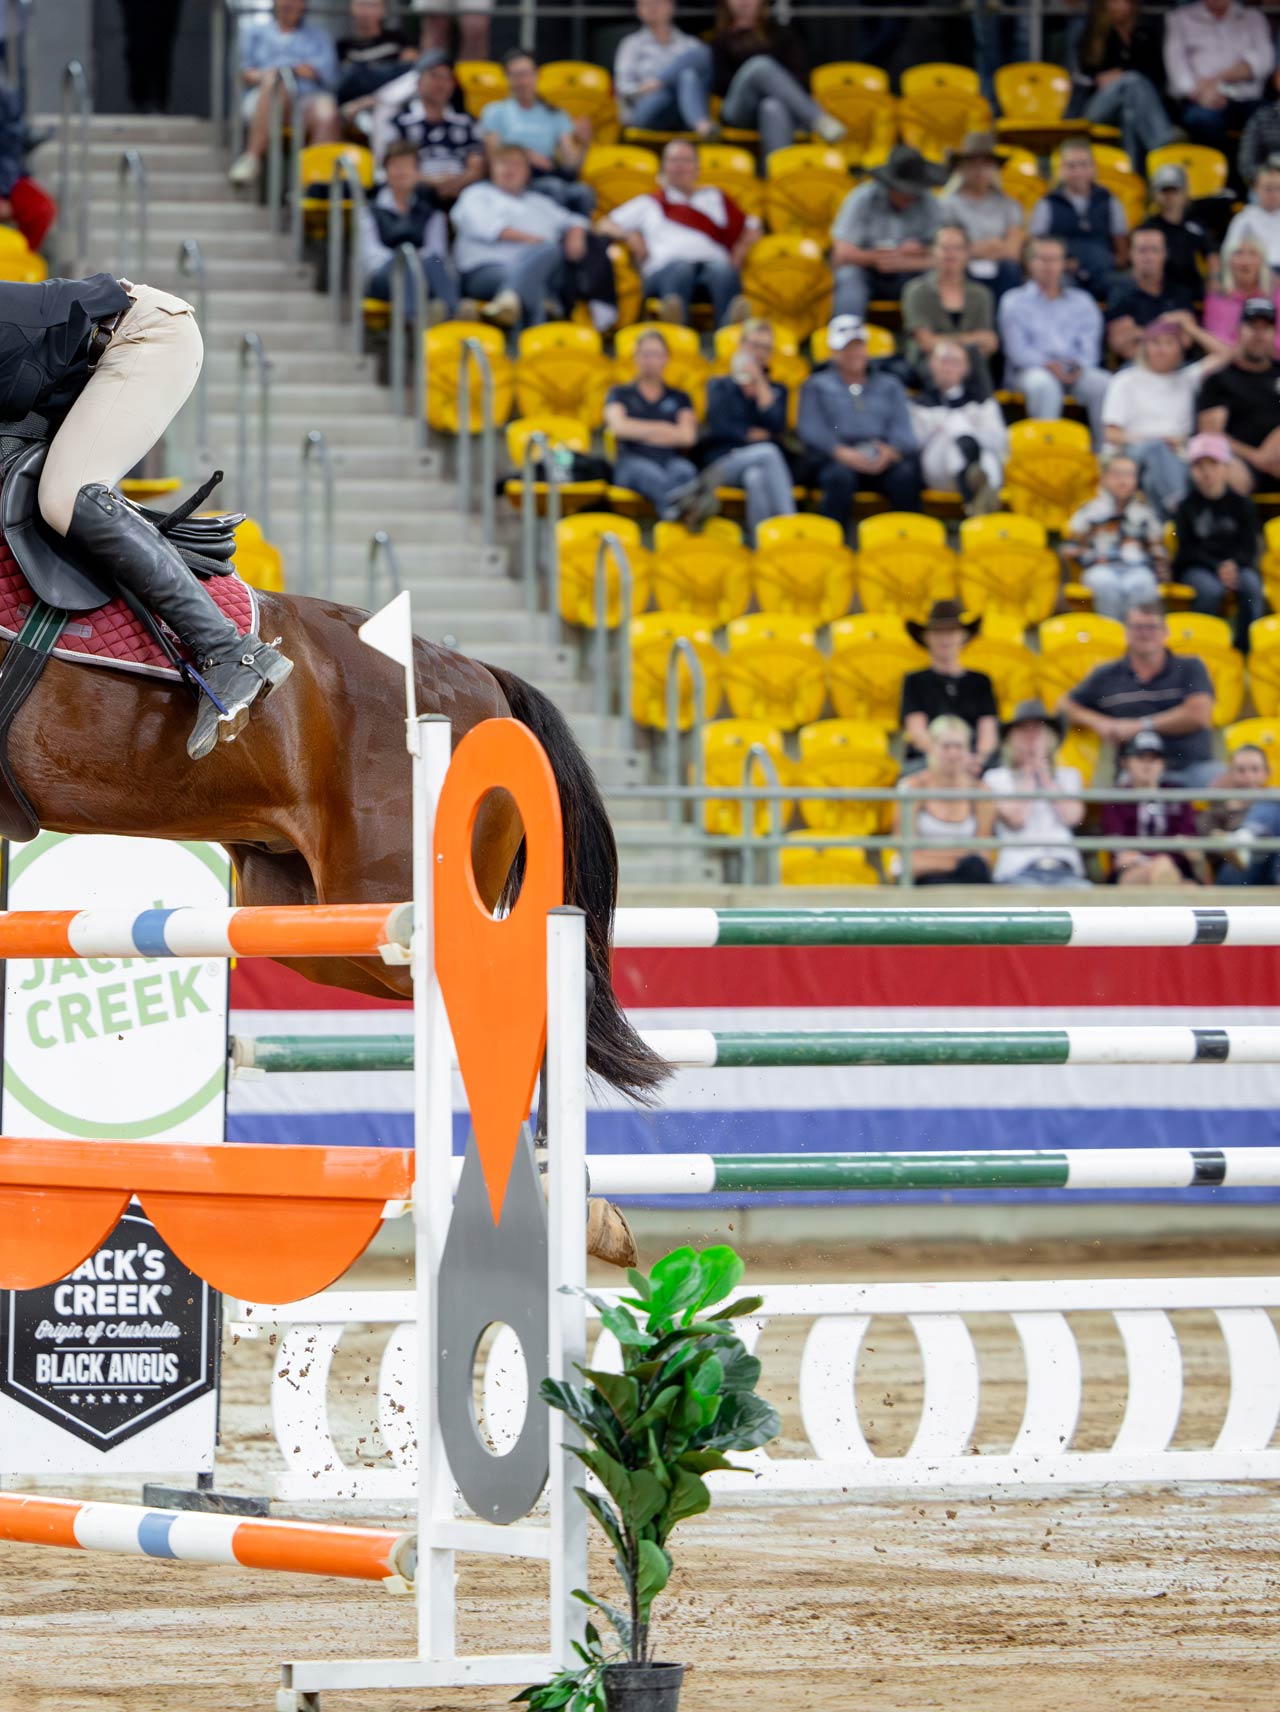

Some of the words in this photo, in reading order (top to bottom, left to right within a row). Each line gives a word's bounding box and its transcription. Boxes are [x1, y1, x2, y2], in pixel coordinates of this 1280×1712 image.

[62, 1242, 166, 1281] ACK'S
[35, 1319, 83, 1344] Origin
[84, 1320, 106, 1344] of
[105, 1320, 182, 1339] Australia
[36, 1353, 105, 1384] BLACK
[107, 1352, 179, 1384] ANGUS
